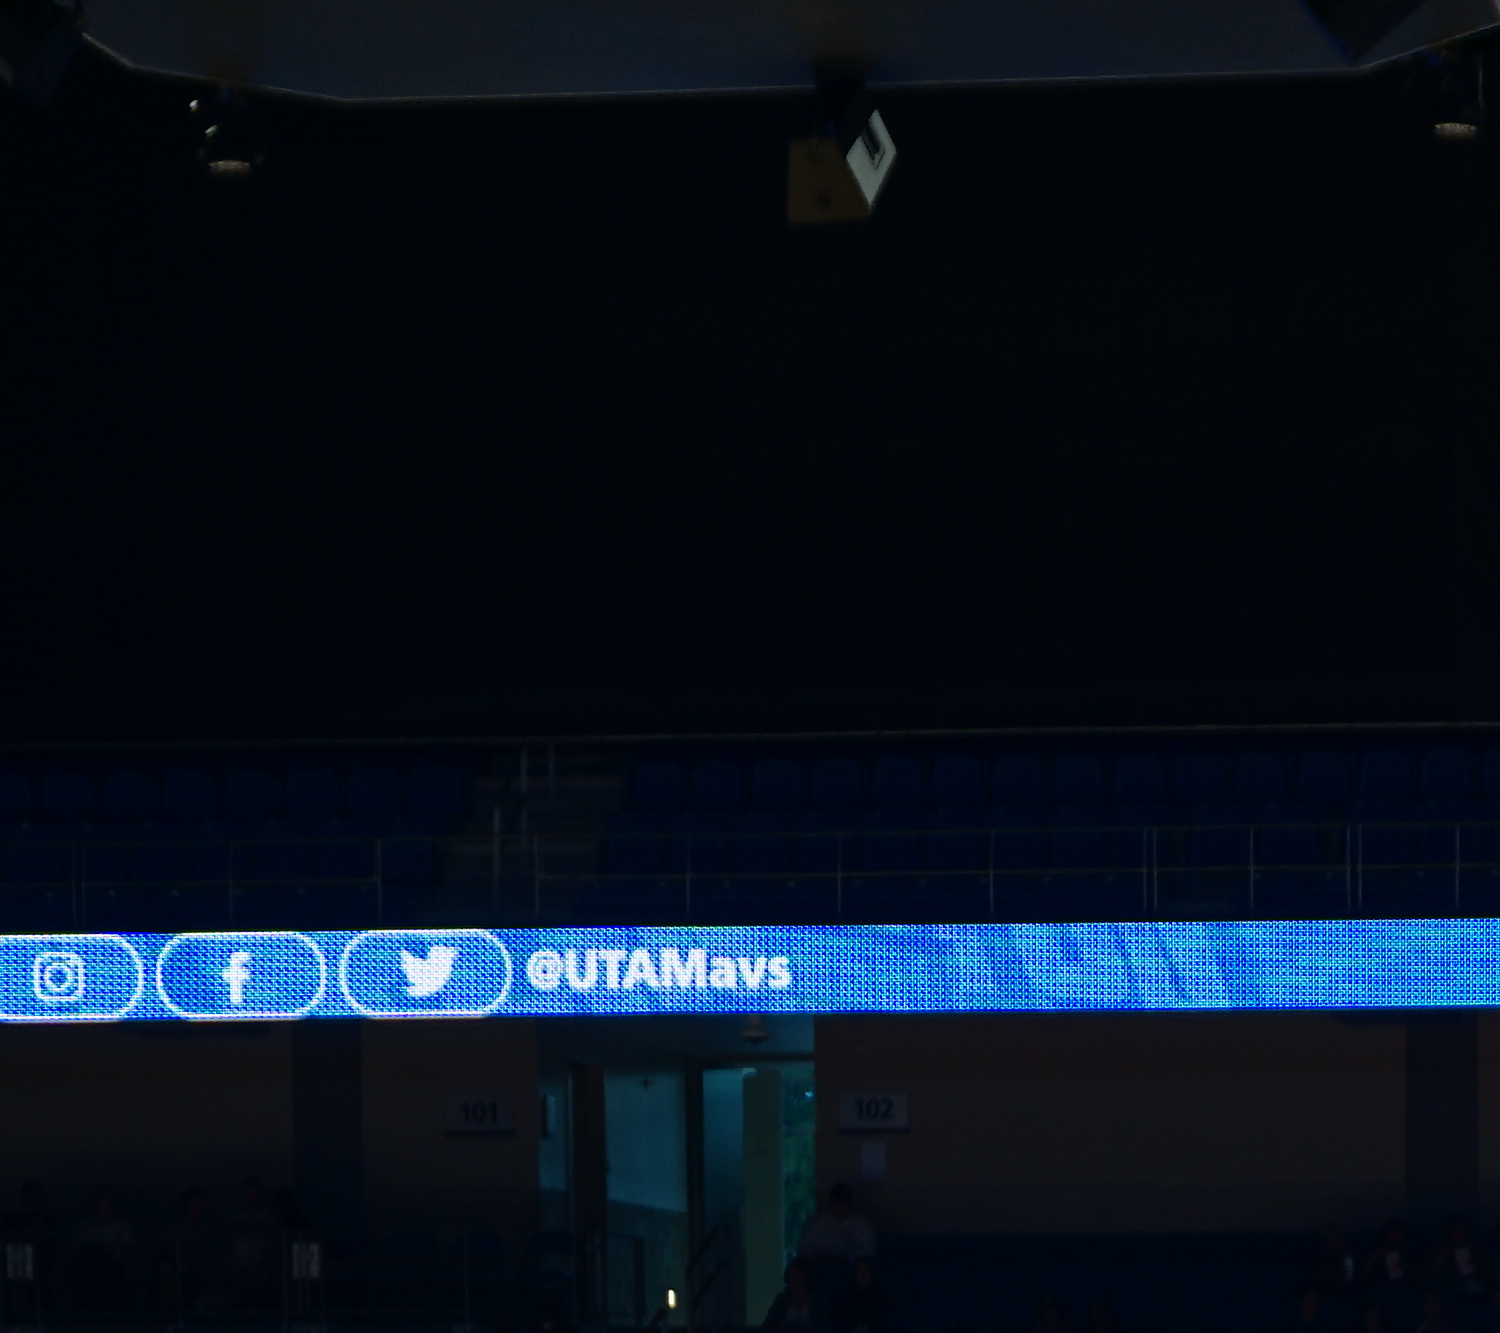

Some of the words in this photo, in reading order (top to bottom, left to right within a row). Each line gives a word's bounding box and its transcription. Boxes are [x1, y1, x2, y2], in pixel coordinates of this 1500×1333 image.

[527, 946, 791, 993] @UTAMavs
[460, 1100, 498, 1123] 101
[854, 1097, 894, 1120] 102
